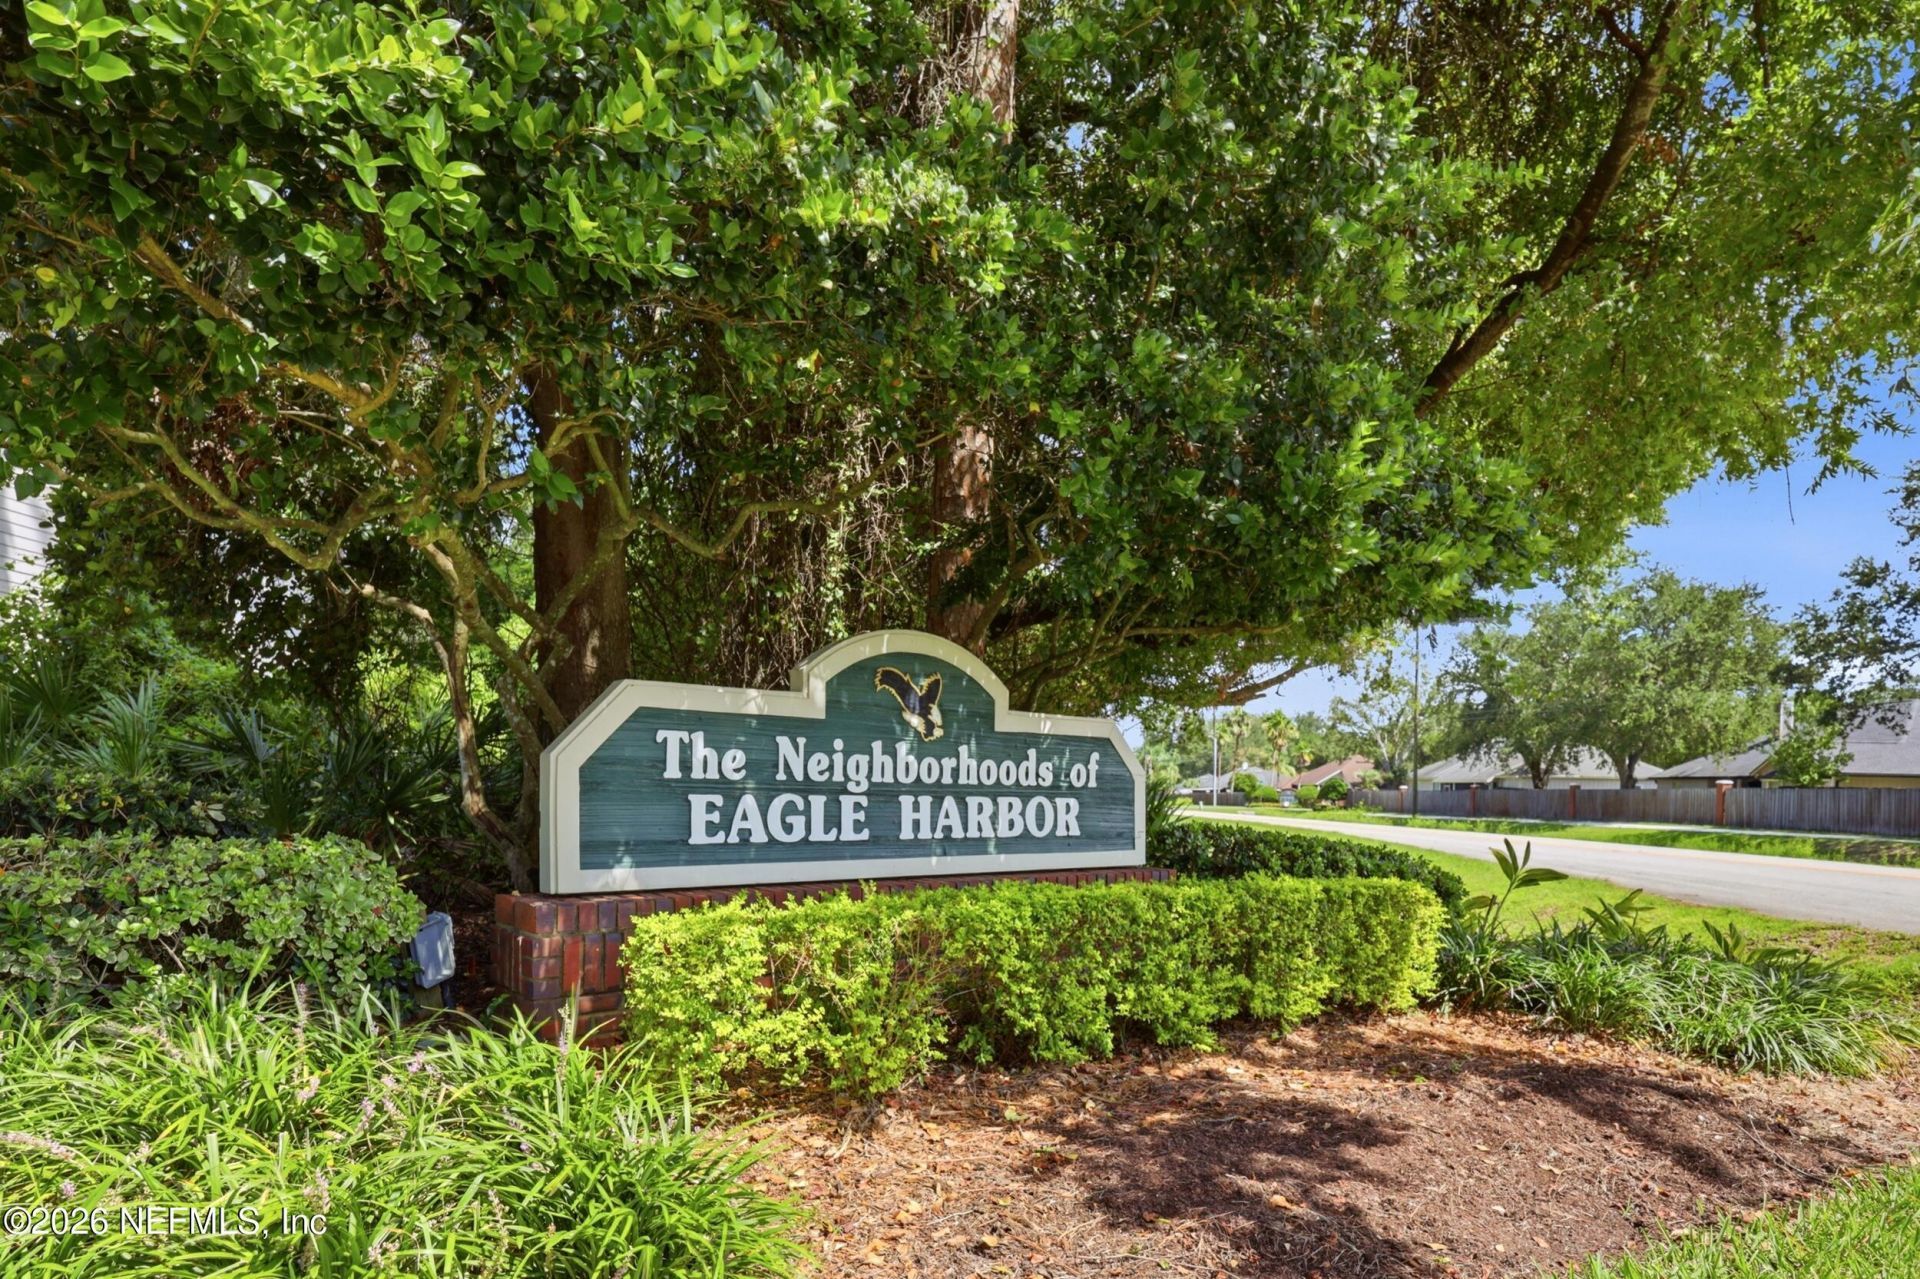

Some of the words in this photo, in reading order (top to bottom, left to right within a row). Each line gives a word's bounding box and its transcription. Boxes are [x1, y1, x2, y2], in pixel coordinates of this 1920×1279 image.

[655, 729, 747, 780] The
[775, 736, 1053, 793] Neighborhoods
[1070, 752, 1100, 788] of
[688, 793, 870, 845] EAGLE
[899, 795, 1081, 840] HARBOR
